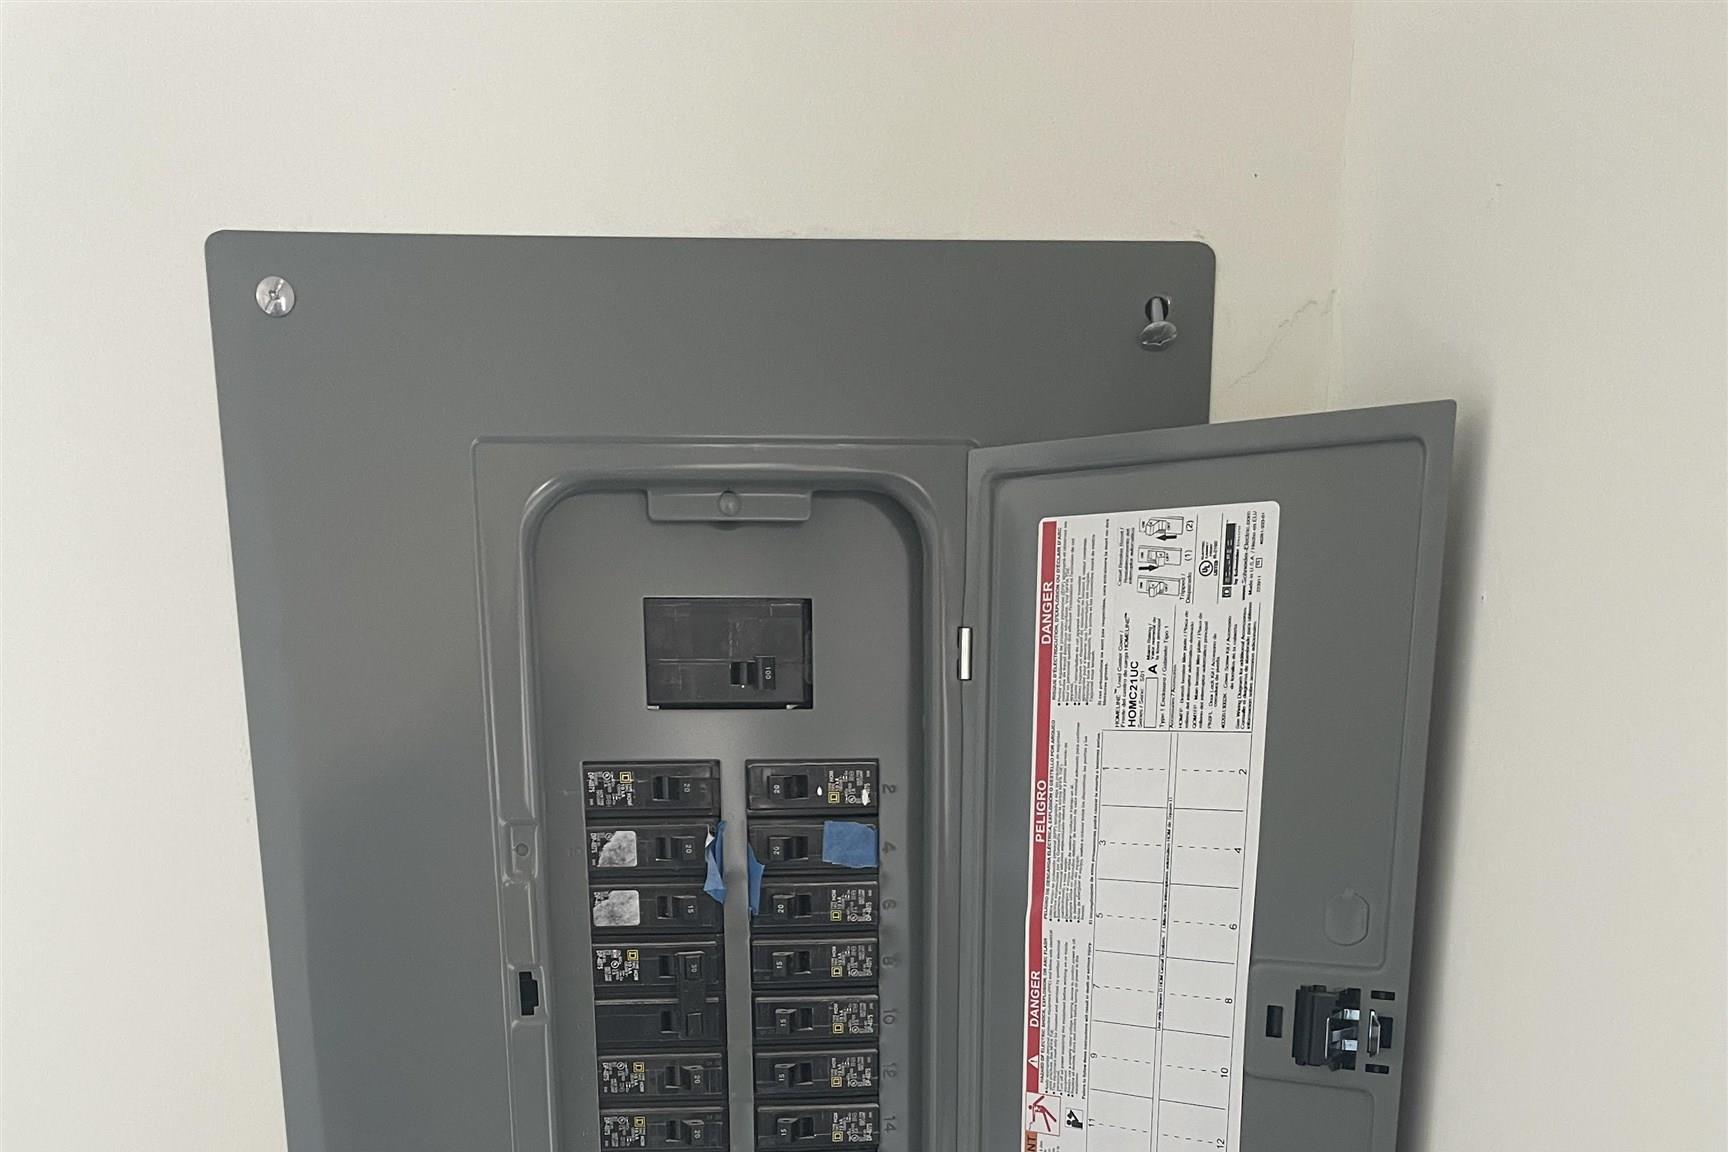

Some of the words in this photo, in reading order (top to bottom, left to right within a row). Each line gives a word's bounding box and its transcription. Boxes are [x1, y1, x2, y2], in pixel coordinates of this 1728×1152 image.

[1186, 520, 1194, 532] (2)
[1041, 581, 1053, 644] DANGER
[1148, 664, 1158, 674] A
[1128, 661, 1138, 727] HOMC21UC
[684, 783, 690, 792] 20
[774, 784, 780, 794] 20
[882, 784, 896, 793] 2
[1035, 780, 1046, 843] PELIGRO
[685, 845, 692, 854] 20
[773, 846, 780, 855] 20
[882, 841, 897, 854] 4
[688, 905, 694, 913] 15
[778, 904, 784, 913] 20
[1030, 971, 1040, 1028] DANGER
[883, 1009, 896, 1025] 10
[883, 1063, 897, 1079] 12
[1221, 1067, 1229, 1078] 10
[694, 1075, 700, 1084] 20
[884, 1116, 896, 1133] 14
[1088, 1118, 1095, 1127] 11
[694, 1130, 700, 1138] 20
[780, 1128, 787, 1136] 15
[1217, 1139, 1225, 1149] 12
